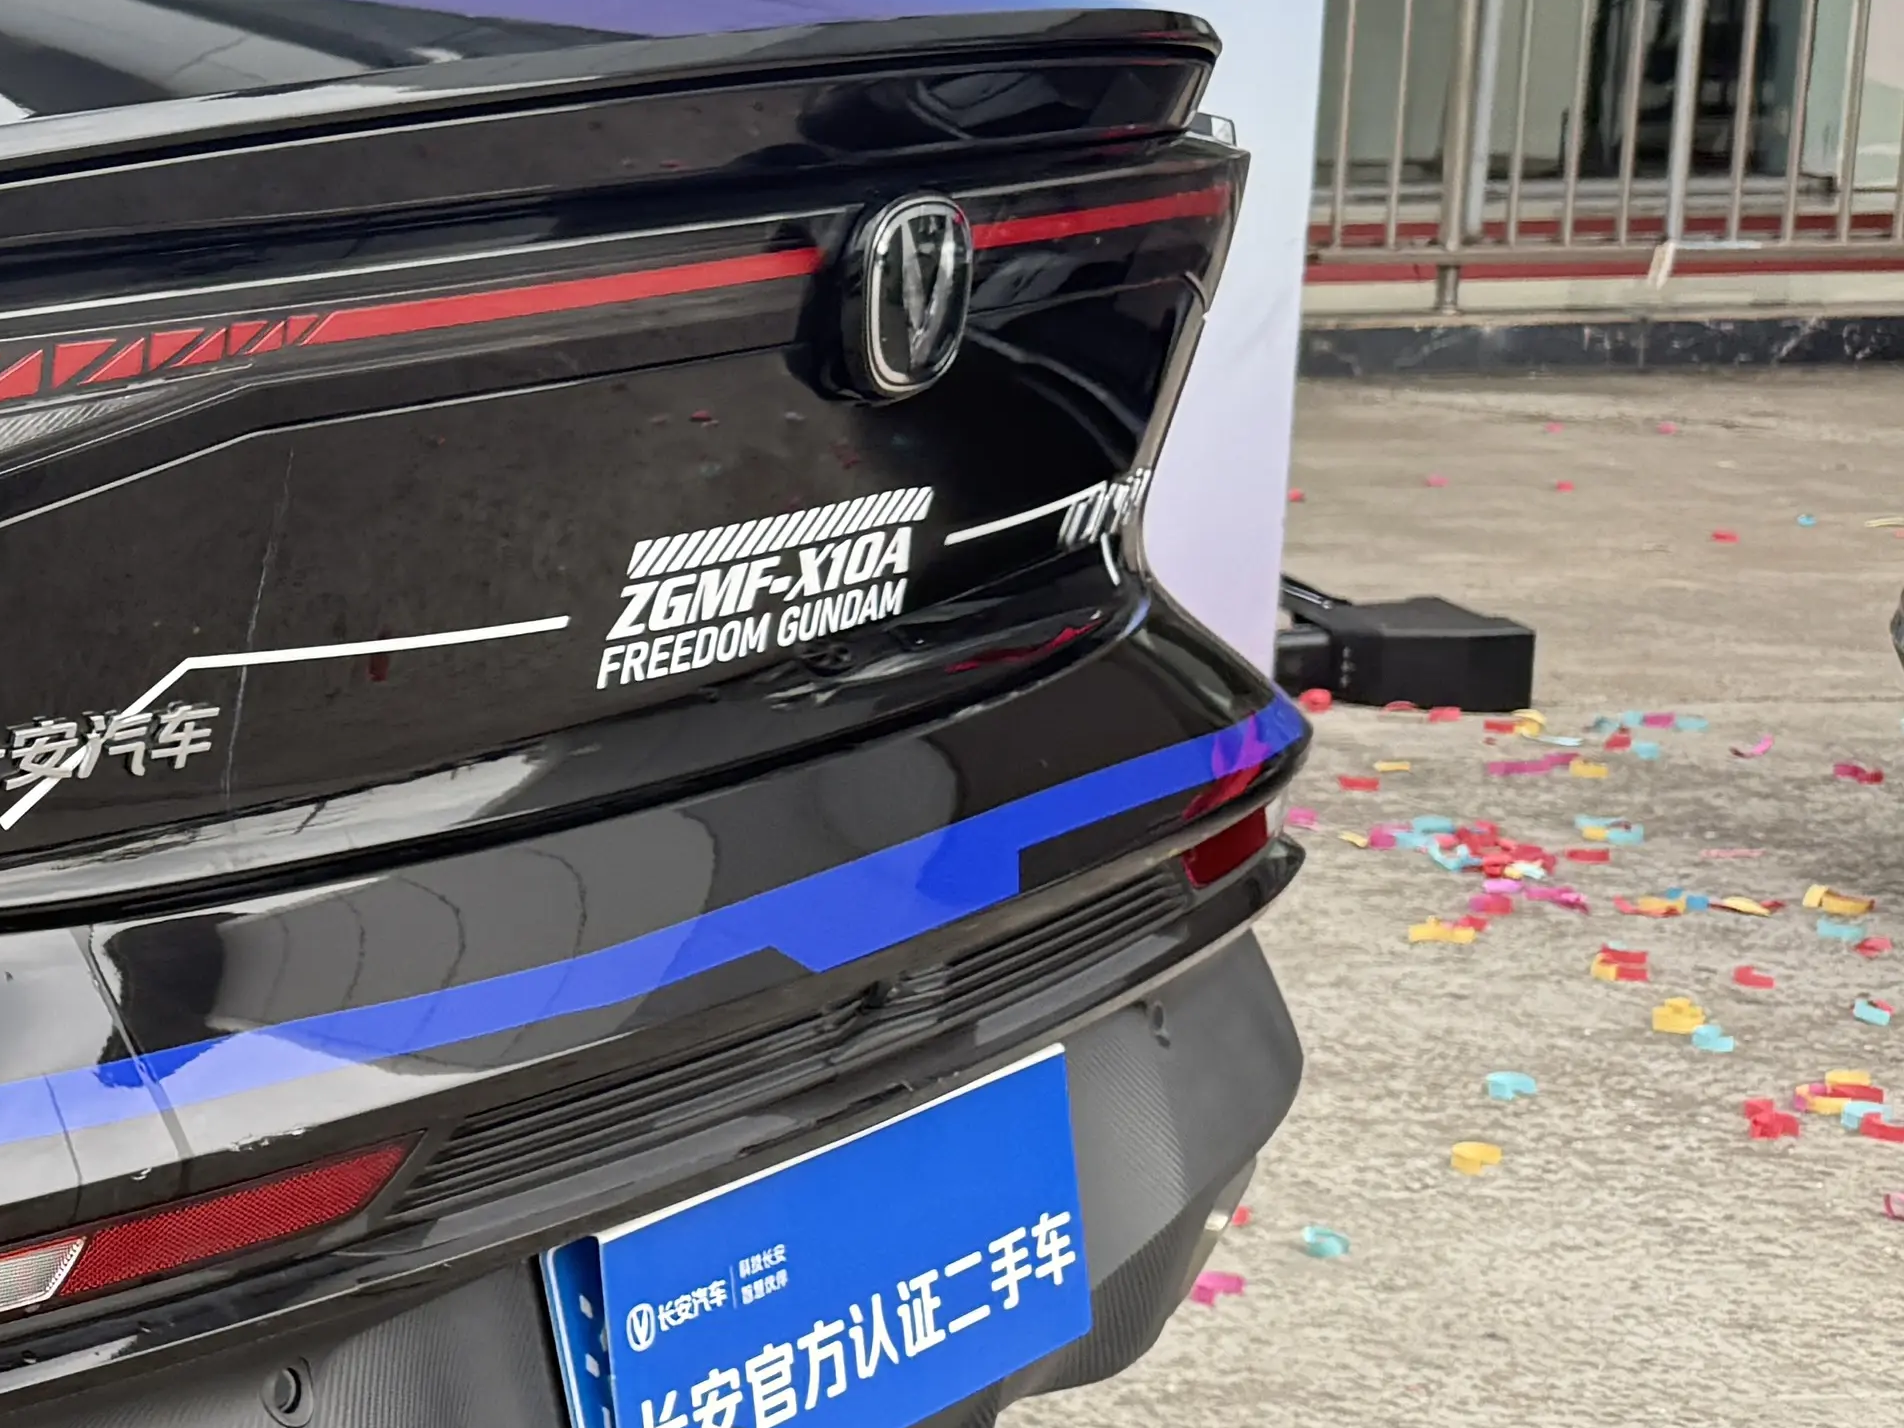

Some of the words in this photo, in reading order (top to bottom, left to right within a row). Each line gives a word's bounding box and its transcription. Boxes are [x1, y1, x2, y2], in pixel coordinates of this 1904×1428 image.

[596, 610, 769, 691] FREEDOM
[776, 577, 909, 649] GUNDAM
[605, 528, 912, 640] ZGMF-X10A
[657, 1279, 728, 1332] 长安汽车
